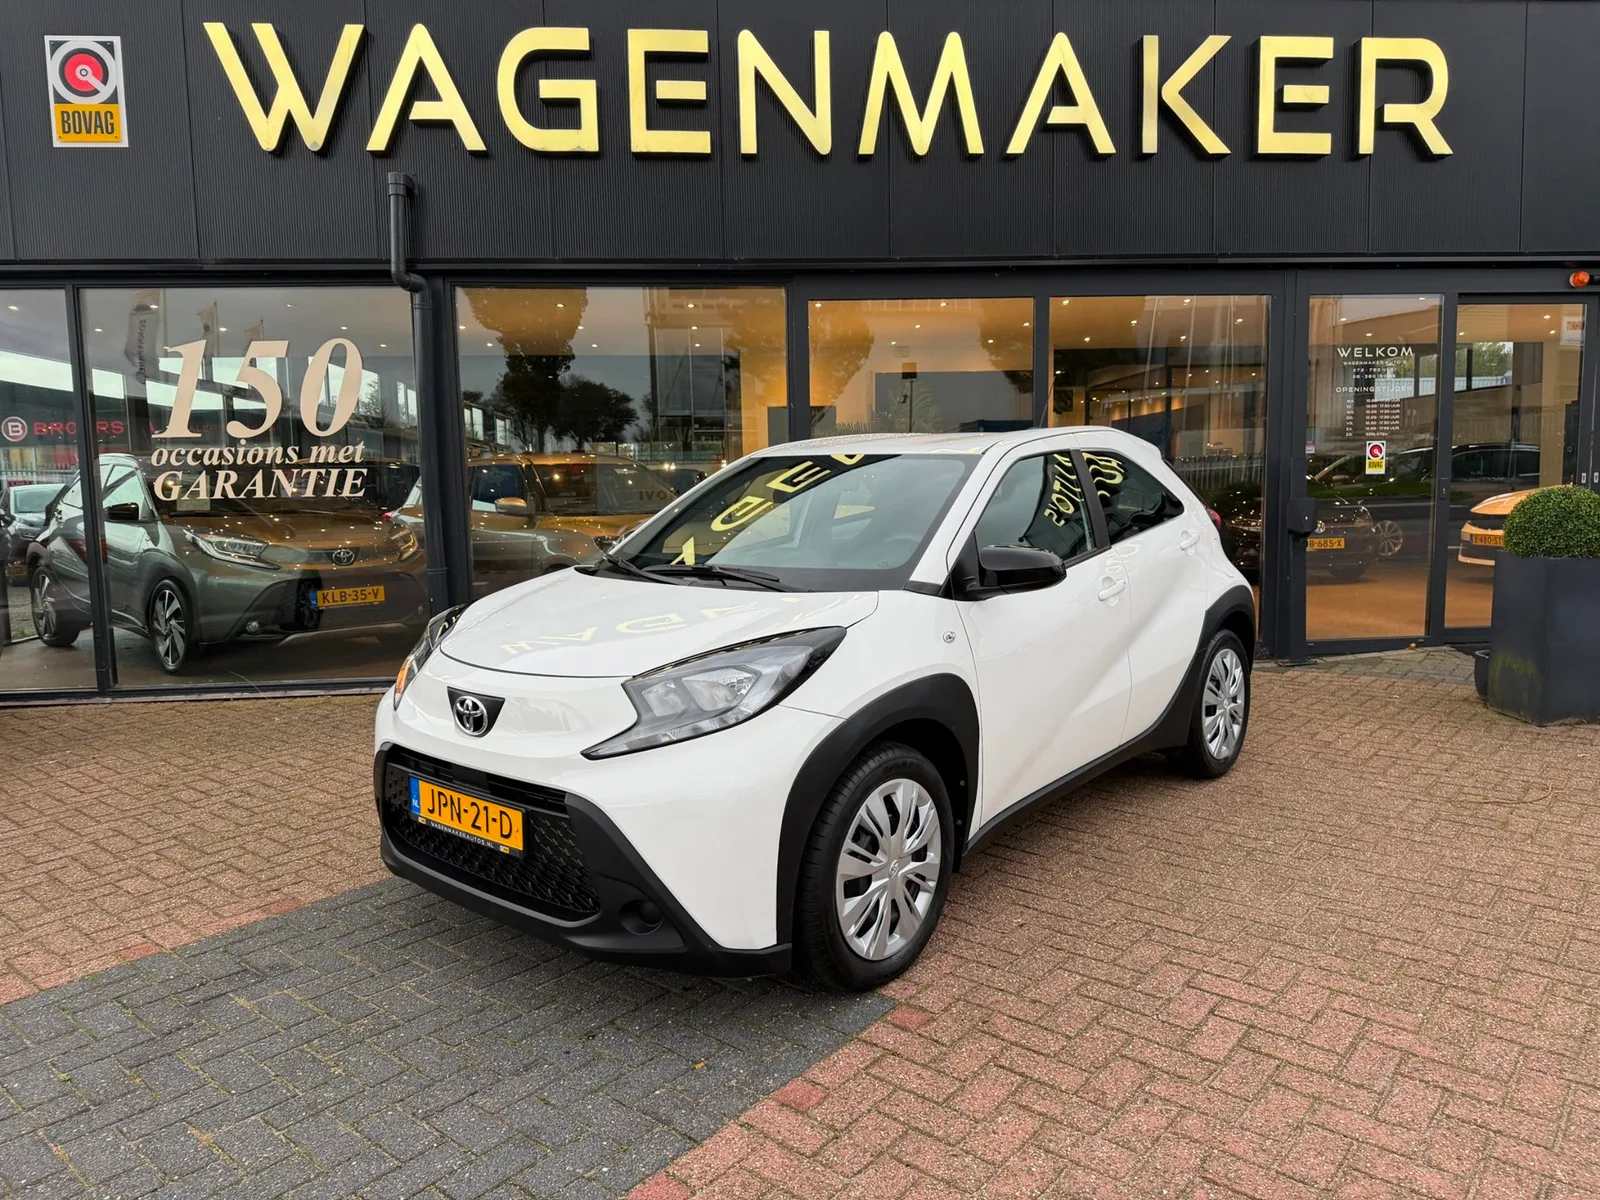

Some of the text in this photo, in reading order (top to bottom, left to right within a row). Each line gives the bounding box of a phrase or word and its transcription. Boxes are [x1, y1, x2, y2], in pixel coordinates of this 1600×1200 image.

[203, 22, 1453, 156] WAGENMAKER
[60, 110, 115, 135] BOVAG
[1337, 346, 1413, 358] WELKOM
[151, 337, 364, 439] 150
[1335, 385, 1413, 393] OPENINGSTIJDEN
[33, 421, 124, 435] BRORS
[151, 438, 365, 467] occasions met
[153, 468, 368, 500] GARANTIE
[1306, 539, 1342, 548] B-685-X
[322, 588, 380, 604] KLB-35-V
[412, 798, 420, 809] NL
[427, 788, 513, 839] JPN-21-D
[430, 821, 495, 849] WAGENMAKERAUTOS.NL
